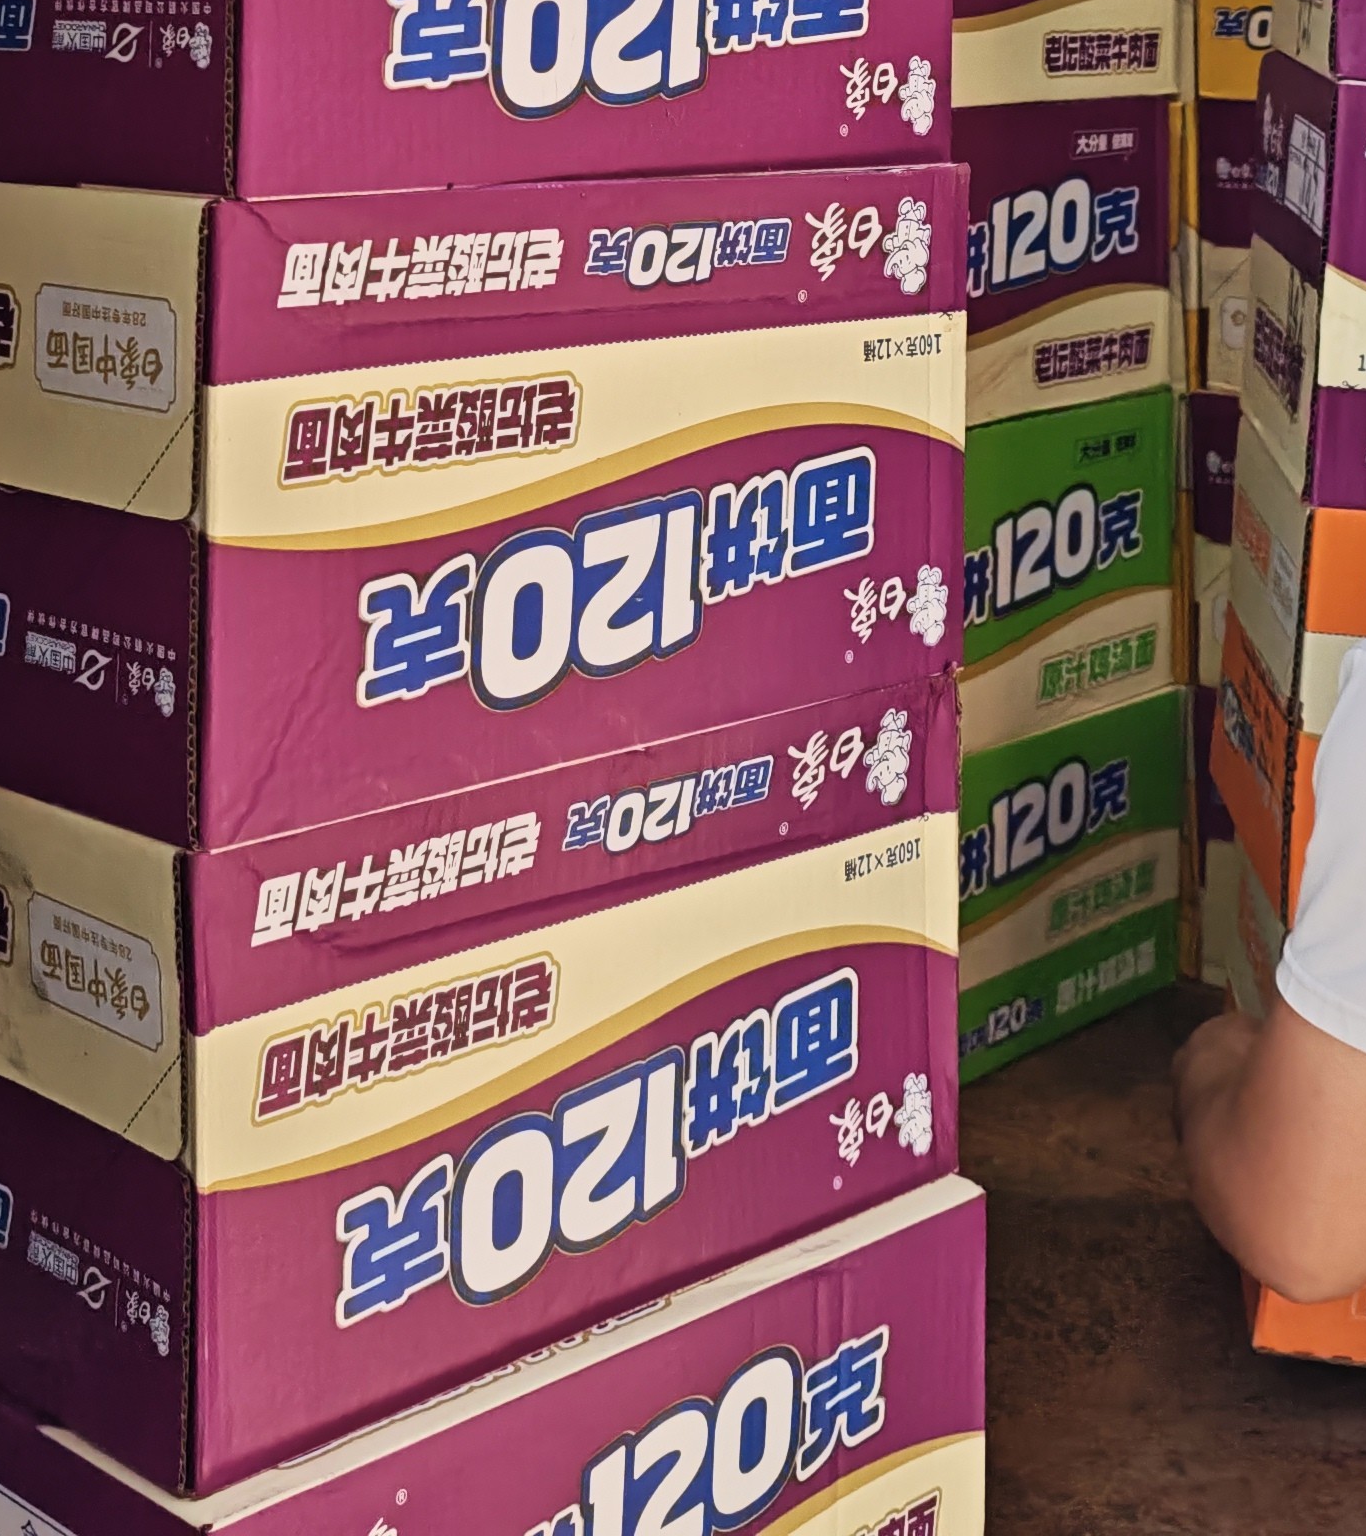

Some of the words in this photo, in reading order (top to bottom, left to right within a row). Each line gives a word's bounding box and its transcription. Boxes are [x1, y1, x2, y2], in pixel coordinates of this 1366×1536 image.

[840, 56, 899, 121] 白象
[1043, 25, 1165, 80] 老坛酸菜牛肉面
[276, 227, 563, 310] 老坛酸菜牛肉面
[586, 217, 792, 290] 面饼120克
[804, 201, 884, 283] 白象
[46, 327, 164, 391] 白象中国面
[862, 332, 944, 364] 160克×12桶
[1033, 324, 1154, 388] 老坛酸菜牛肉面
[278, 369, 582, 490] 老坛酸菜牛肉面
[356, 446, 876, 713] 面饼120克
[843, 576, 909, 645] 白象
[563, 756, 775, 856] 面饼120克
[788, 727, 865, 810] 白象
[250, 814, 542, 949] 老坛酸菜牛肉面
[842, 837, 923, 884] 160克×12桶
[39, 944, 151, 1025] 白象中国面
[251, 953, 562, 1128] 老坛酸菜牛肉面
[335, 968, 859, 1329] 面饼120克
[830, 1098, 894, 1170] 白象
